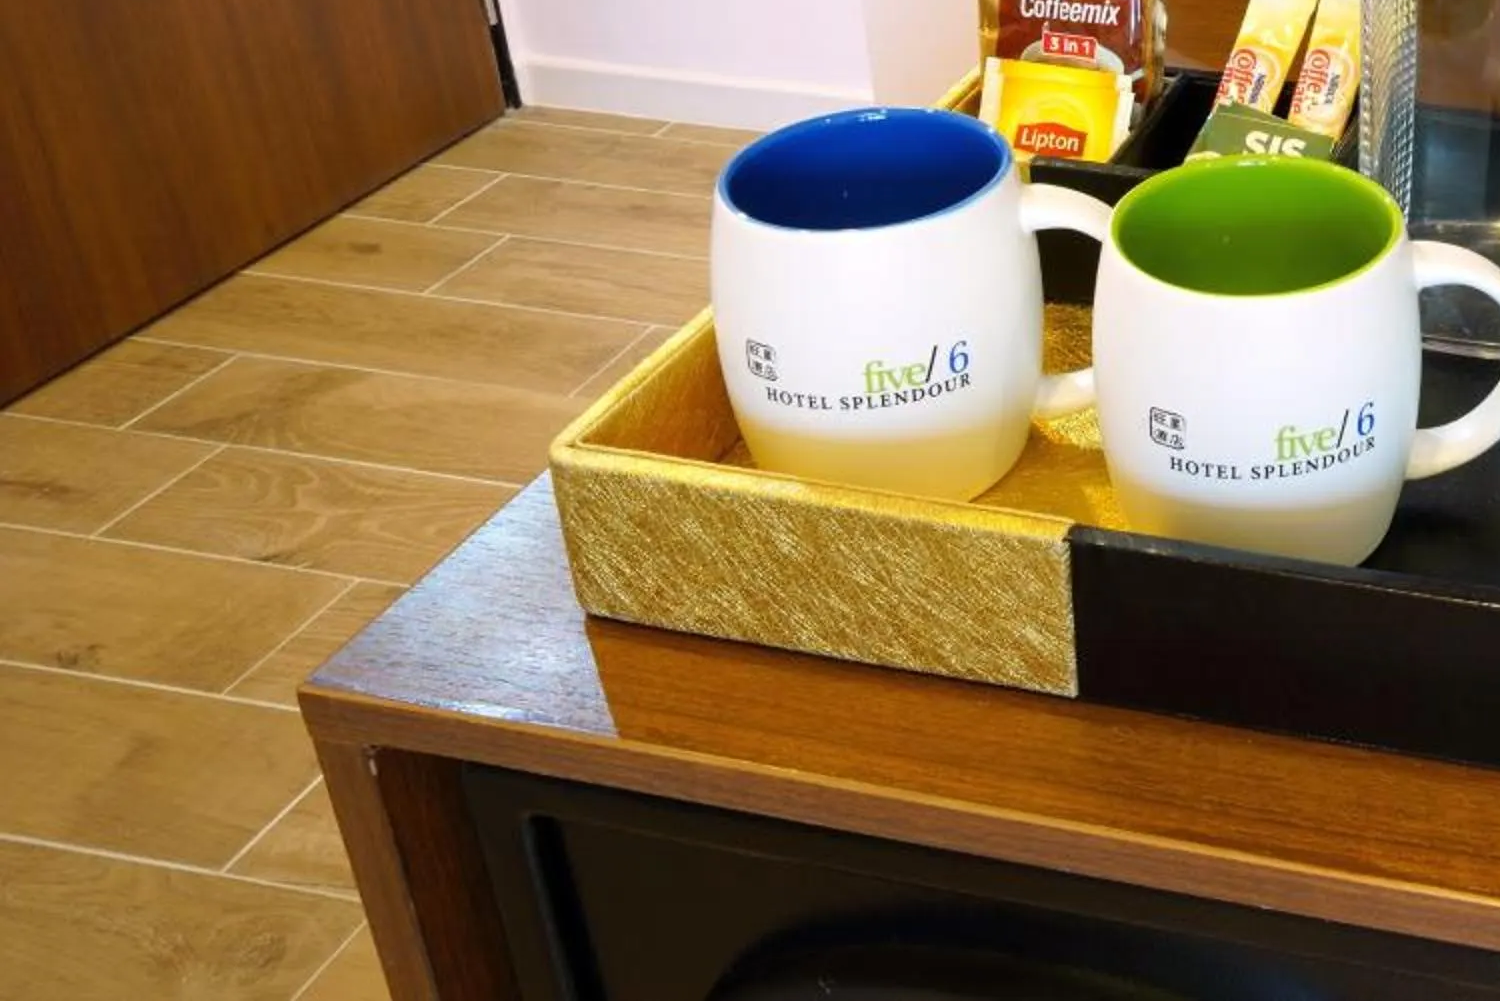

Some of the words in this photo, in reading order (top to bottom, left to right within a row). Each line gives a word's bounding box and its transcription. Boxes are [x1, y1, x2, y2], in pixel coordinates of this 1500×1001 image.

[1049, 37, 1060, 52] 3
[1063, 39, 1079, 53] in
[1082, 41, 1092, 56] 1
[1019, 127, 1080, 152] Lipton
[765, 386, 833, 411] HOTEL
[839, 372, 972, 411] SPLENDOUR
[1169, 456, 1242, 480] HOTEL
[1250, 435, 1376, 480] SPLENDOUR
